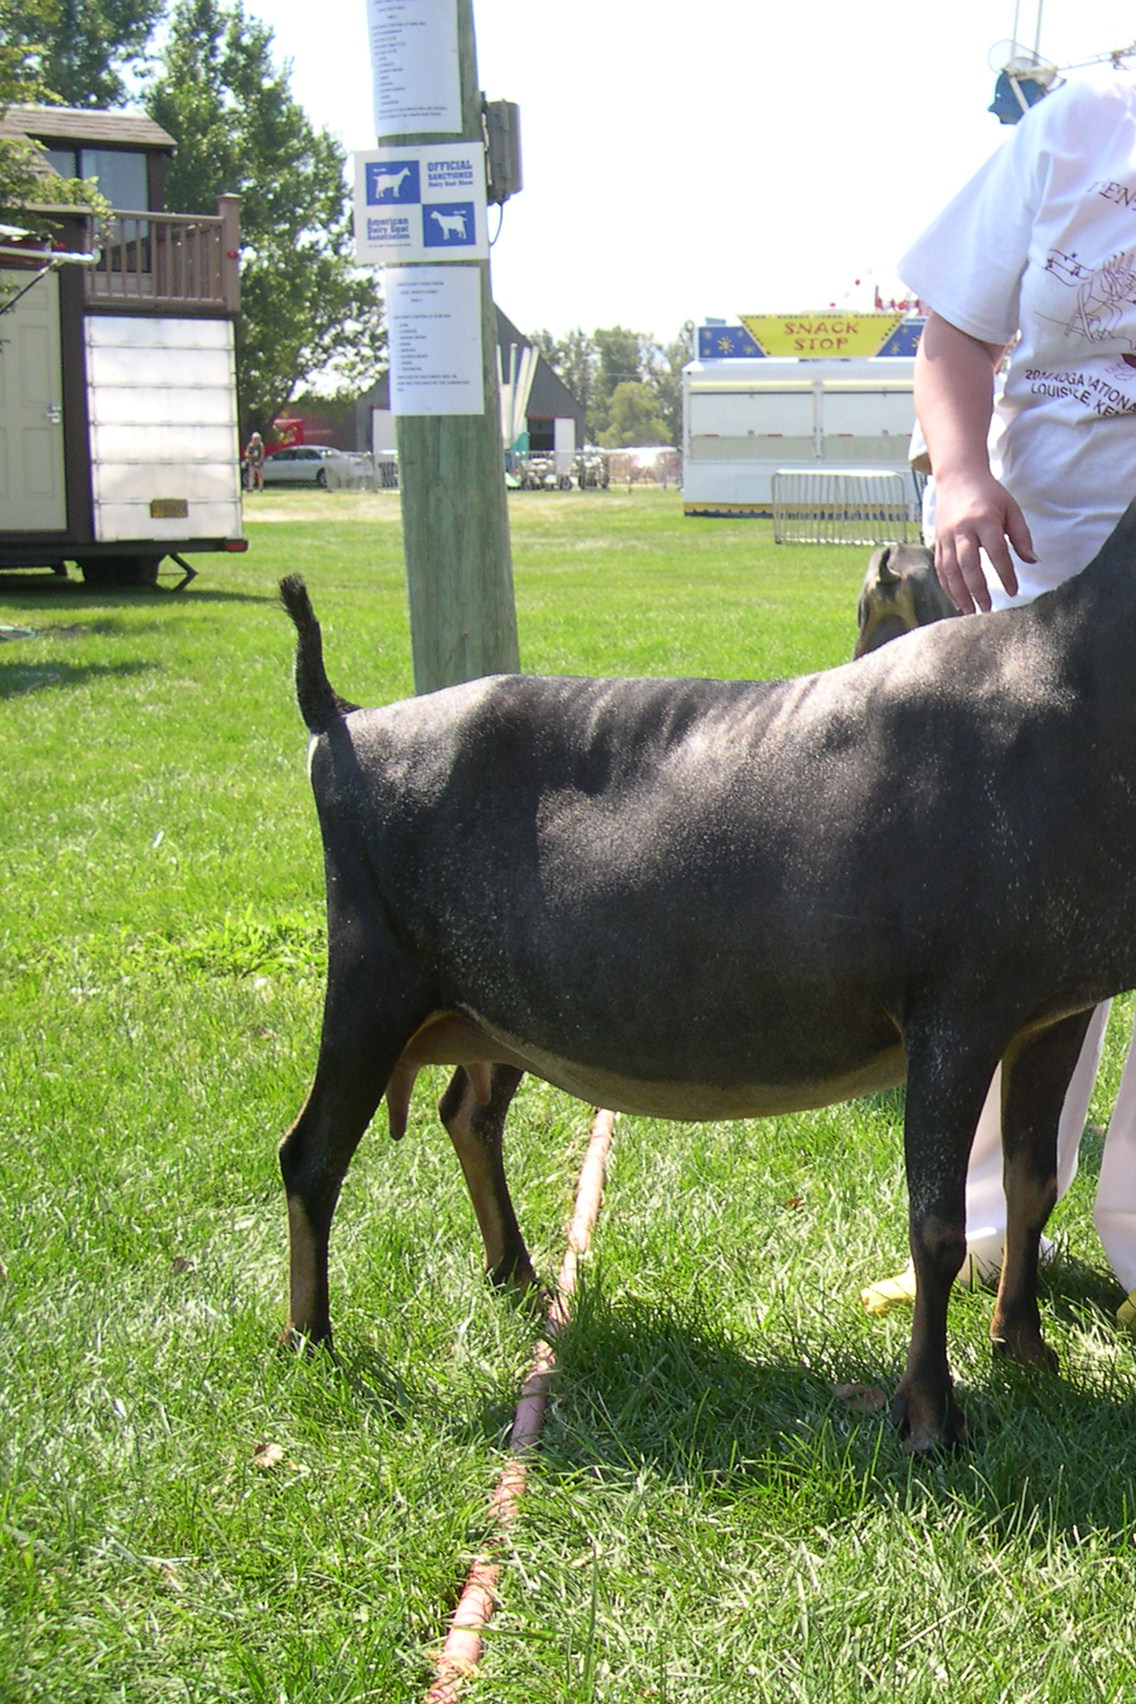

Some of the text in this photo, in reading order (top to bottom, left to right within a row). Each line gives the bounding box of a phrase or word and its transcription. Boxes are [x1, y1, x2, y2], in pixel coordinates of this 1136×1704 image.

[427, 160, 473, 172] OFFICIAL
[427, 171, 473, 180] SANCTIONED
[367, 218, 409, 226] American
[784, 321, 859, 335] SNACK
[794, 336, 848, 351] STOP
